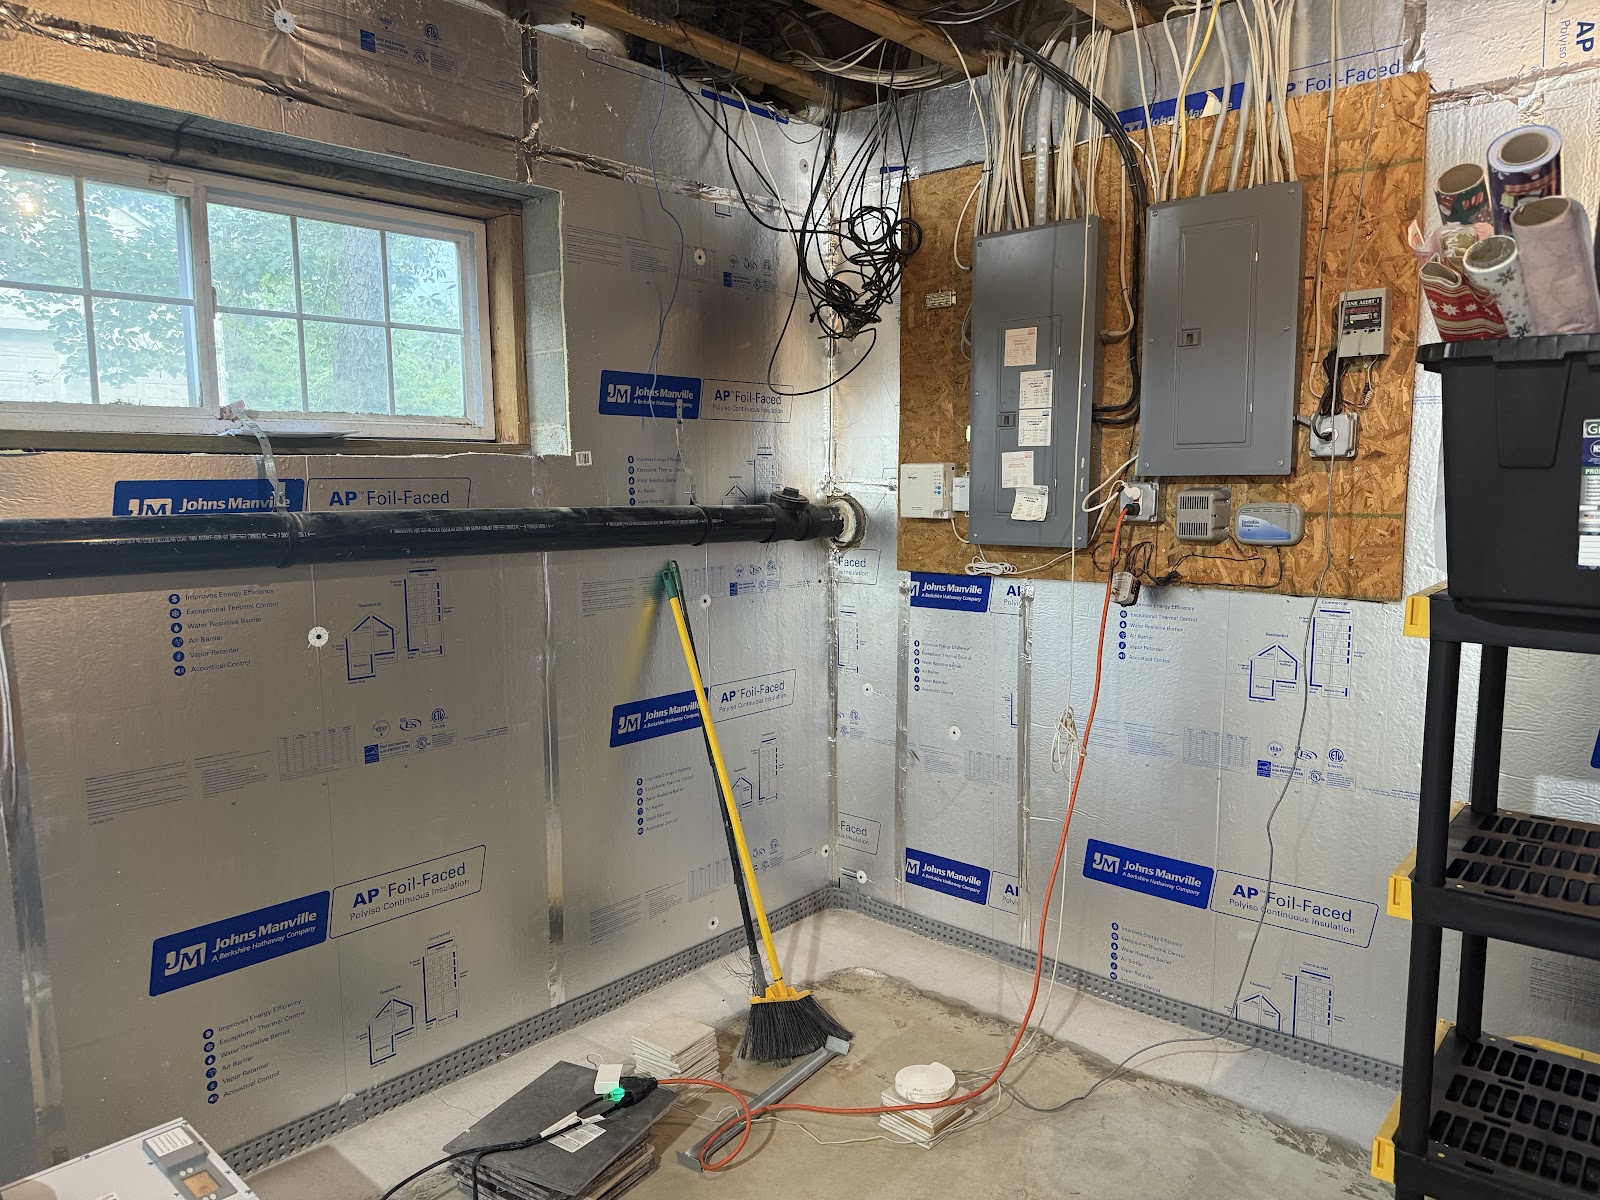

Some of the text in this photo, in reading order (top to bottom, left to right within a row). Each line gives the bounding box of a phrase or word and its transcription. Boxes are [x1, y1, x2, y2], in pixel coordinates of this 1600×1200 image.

[1560, 20, 1570, 58] Polyiso
[607, 384, 631, 403] JM
[660, 388, 694, 400] Manville
[735, 391, 782, 405] Foil-Faced
[179, 498, 290, 513] Johns Manvie
[367, 490, 450, 506] Foil-Faced
[922, 582, 982, 594] Johns Manville
[186, 606, 225, 615] Exceptional
[191, 660, 250, 672] Acoustical Control
[740, 680, 785, 699] Foil-Faced
[618, 713, 641, 734] JM
[644, 709, 668, 722] Johns
[845, 834, 870, 845] Insulation
[1093, 852, 1120, 874] JM
[1123, 860, 1201, 887] Johns Manville
[388, 862, 466, 897] Foil-Faced
[922, 863, 982, 886] Johns Manville
[1127, 873, 1149, 883] Berkshire
[1150, 878, 1175, 890] Hathaway
[1176, 884, 1200, 896] Company
[350, 879, 470, 921] Polyiso Continuous Insulation
[1267, 892, 1352, 922] Foil-Faced
[1229, 898, 1258, 912] Polyiso
[1312, 917, 1354, 934] Insulation
[212, 910, 317, 952] Johns Manville
[219, 946, 251, 959] Berkshire
[252, 935, 285, 950] Hathaway
[286, 925, 316, 939] Company
[164, 942, 207, 976] JM
[218, 1000, 302, 1032] Improves Energy Efficiency
[220, 1010, 306, 1045] Exceptional Thermal Control
[220, 1029, 290, 1058] Water Resistive Barrier
[233, 1055, 254, 1067] Barrier
[222, 1062, 269, 1084] Vapor Retarder
[223, 1070, 280, 1097] Acoustical Control
